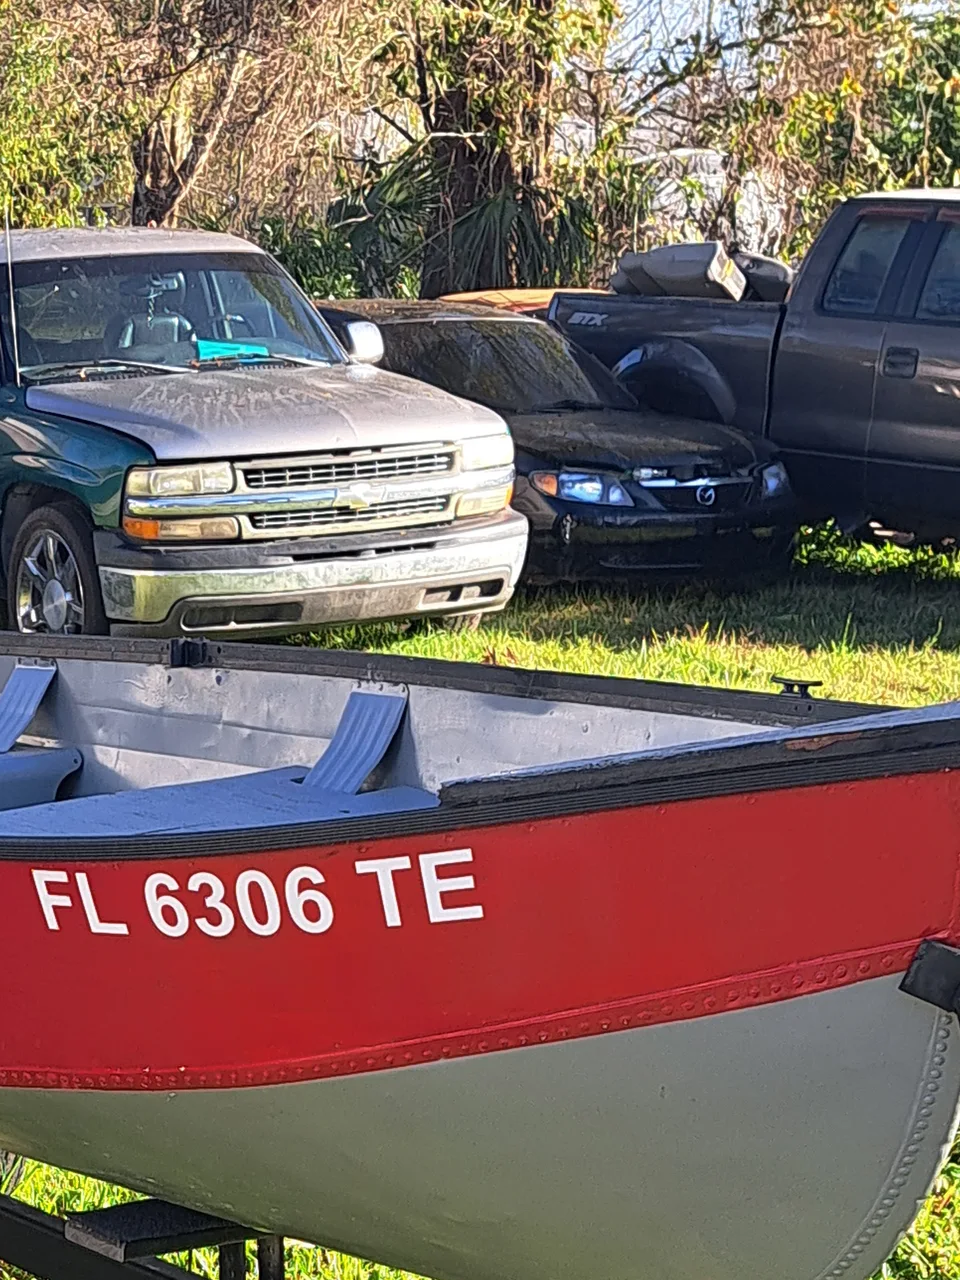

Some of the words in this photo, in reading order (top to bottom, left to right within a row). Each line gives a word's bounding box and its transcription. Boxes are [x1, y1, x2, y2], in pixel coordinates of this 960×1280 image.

[31, 869, 129, 935] FL
[144, 866, 334, 937] 6306
[354, 848, 484, 928] TE
